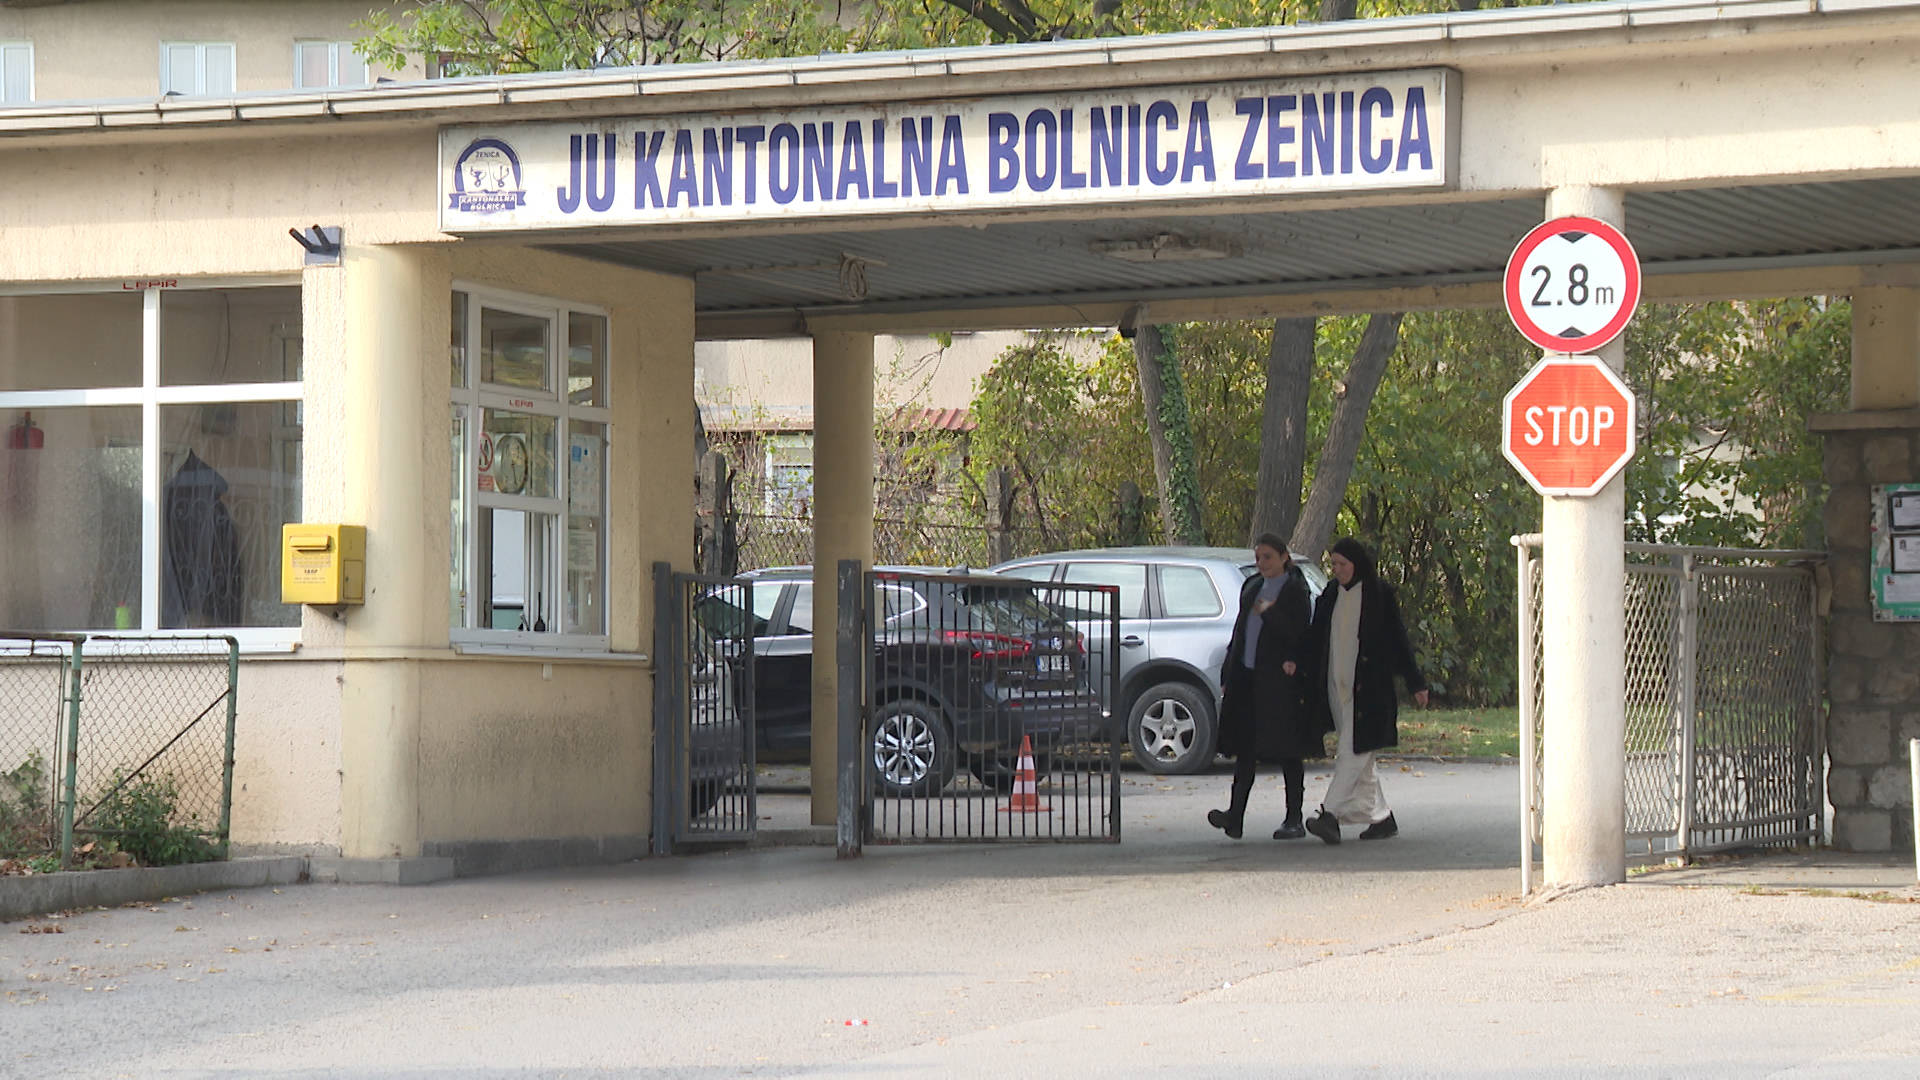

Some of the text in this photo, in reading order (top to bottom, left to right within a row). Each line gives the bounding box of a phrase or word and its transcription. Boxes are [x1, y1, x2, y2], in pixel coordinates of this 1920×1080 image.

[558, 86, 1433, 214] JU KANTONALNA BOLNICA ZENICA
[122, 279, 178, 290] LEPIR
[1524, 405, 1615, 447] STOP
